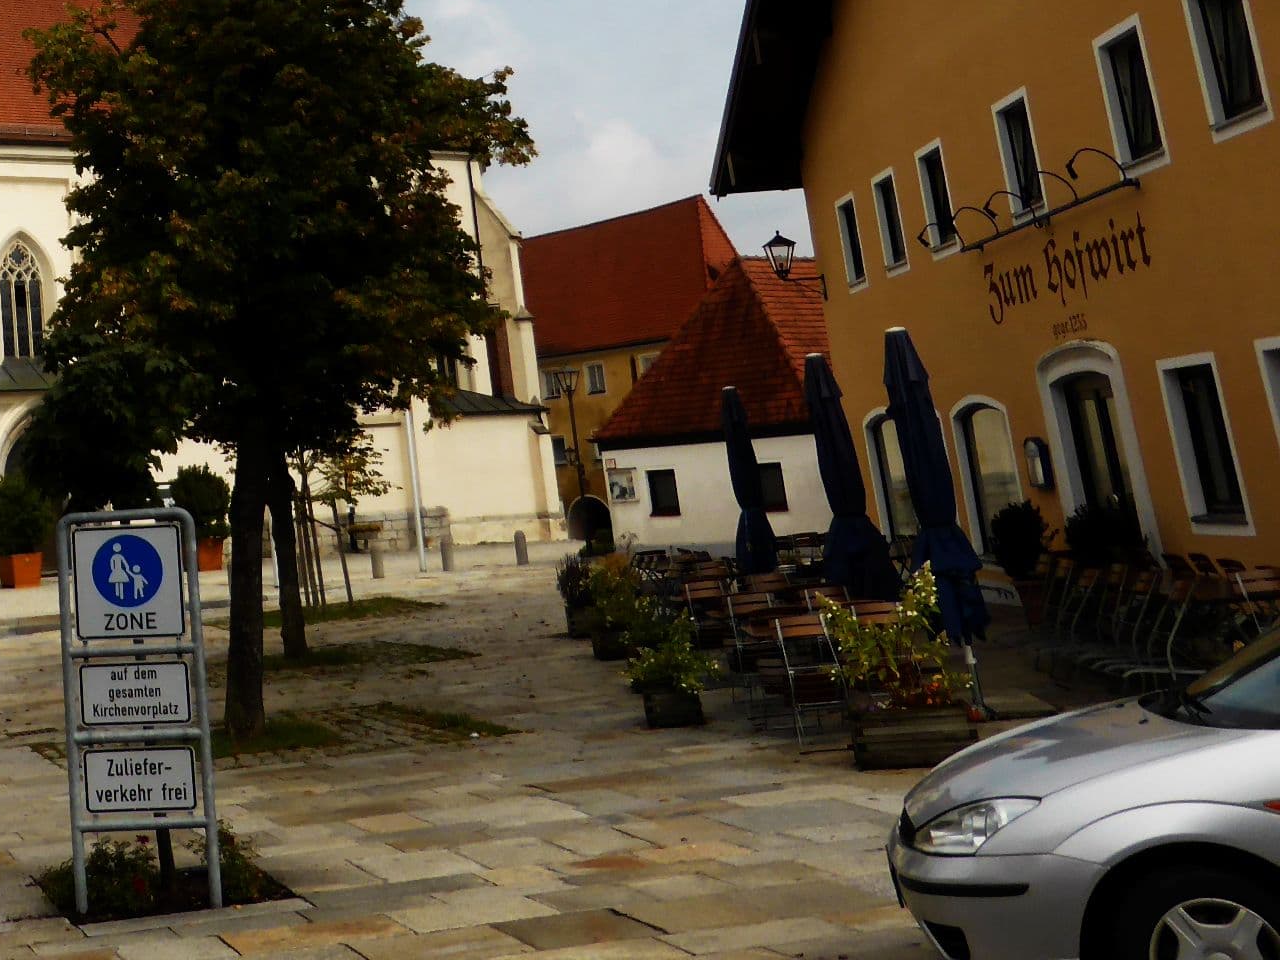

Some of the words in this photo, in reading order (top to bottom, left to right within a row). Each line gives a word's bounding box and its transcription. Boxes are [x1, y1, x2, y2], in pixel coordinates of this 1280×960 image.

[983, 261, 1038, 325] Zum
[1043, 209, 1151, 307] Hofwirt
[104, 612, 158, 631] ZONE
[110, 667, 128, 681] auf
[134, 665, 157, 680] dem
[108, 685, 161, 702] gesamten
[92, 702, 179, 718] Kirchenvorplatz
[106, 758, 173, 777] Zuliefer-
[95, 784, 153, 803] verkehr
[162, 782, 188, 801] frei
